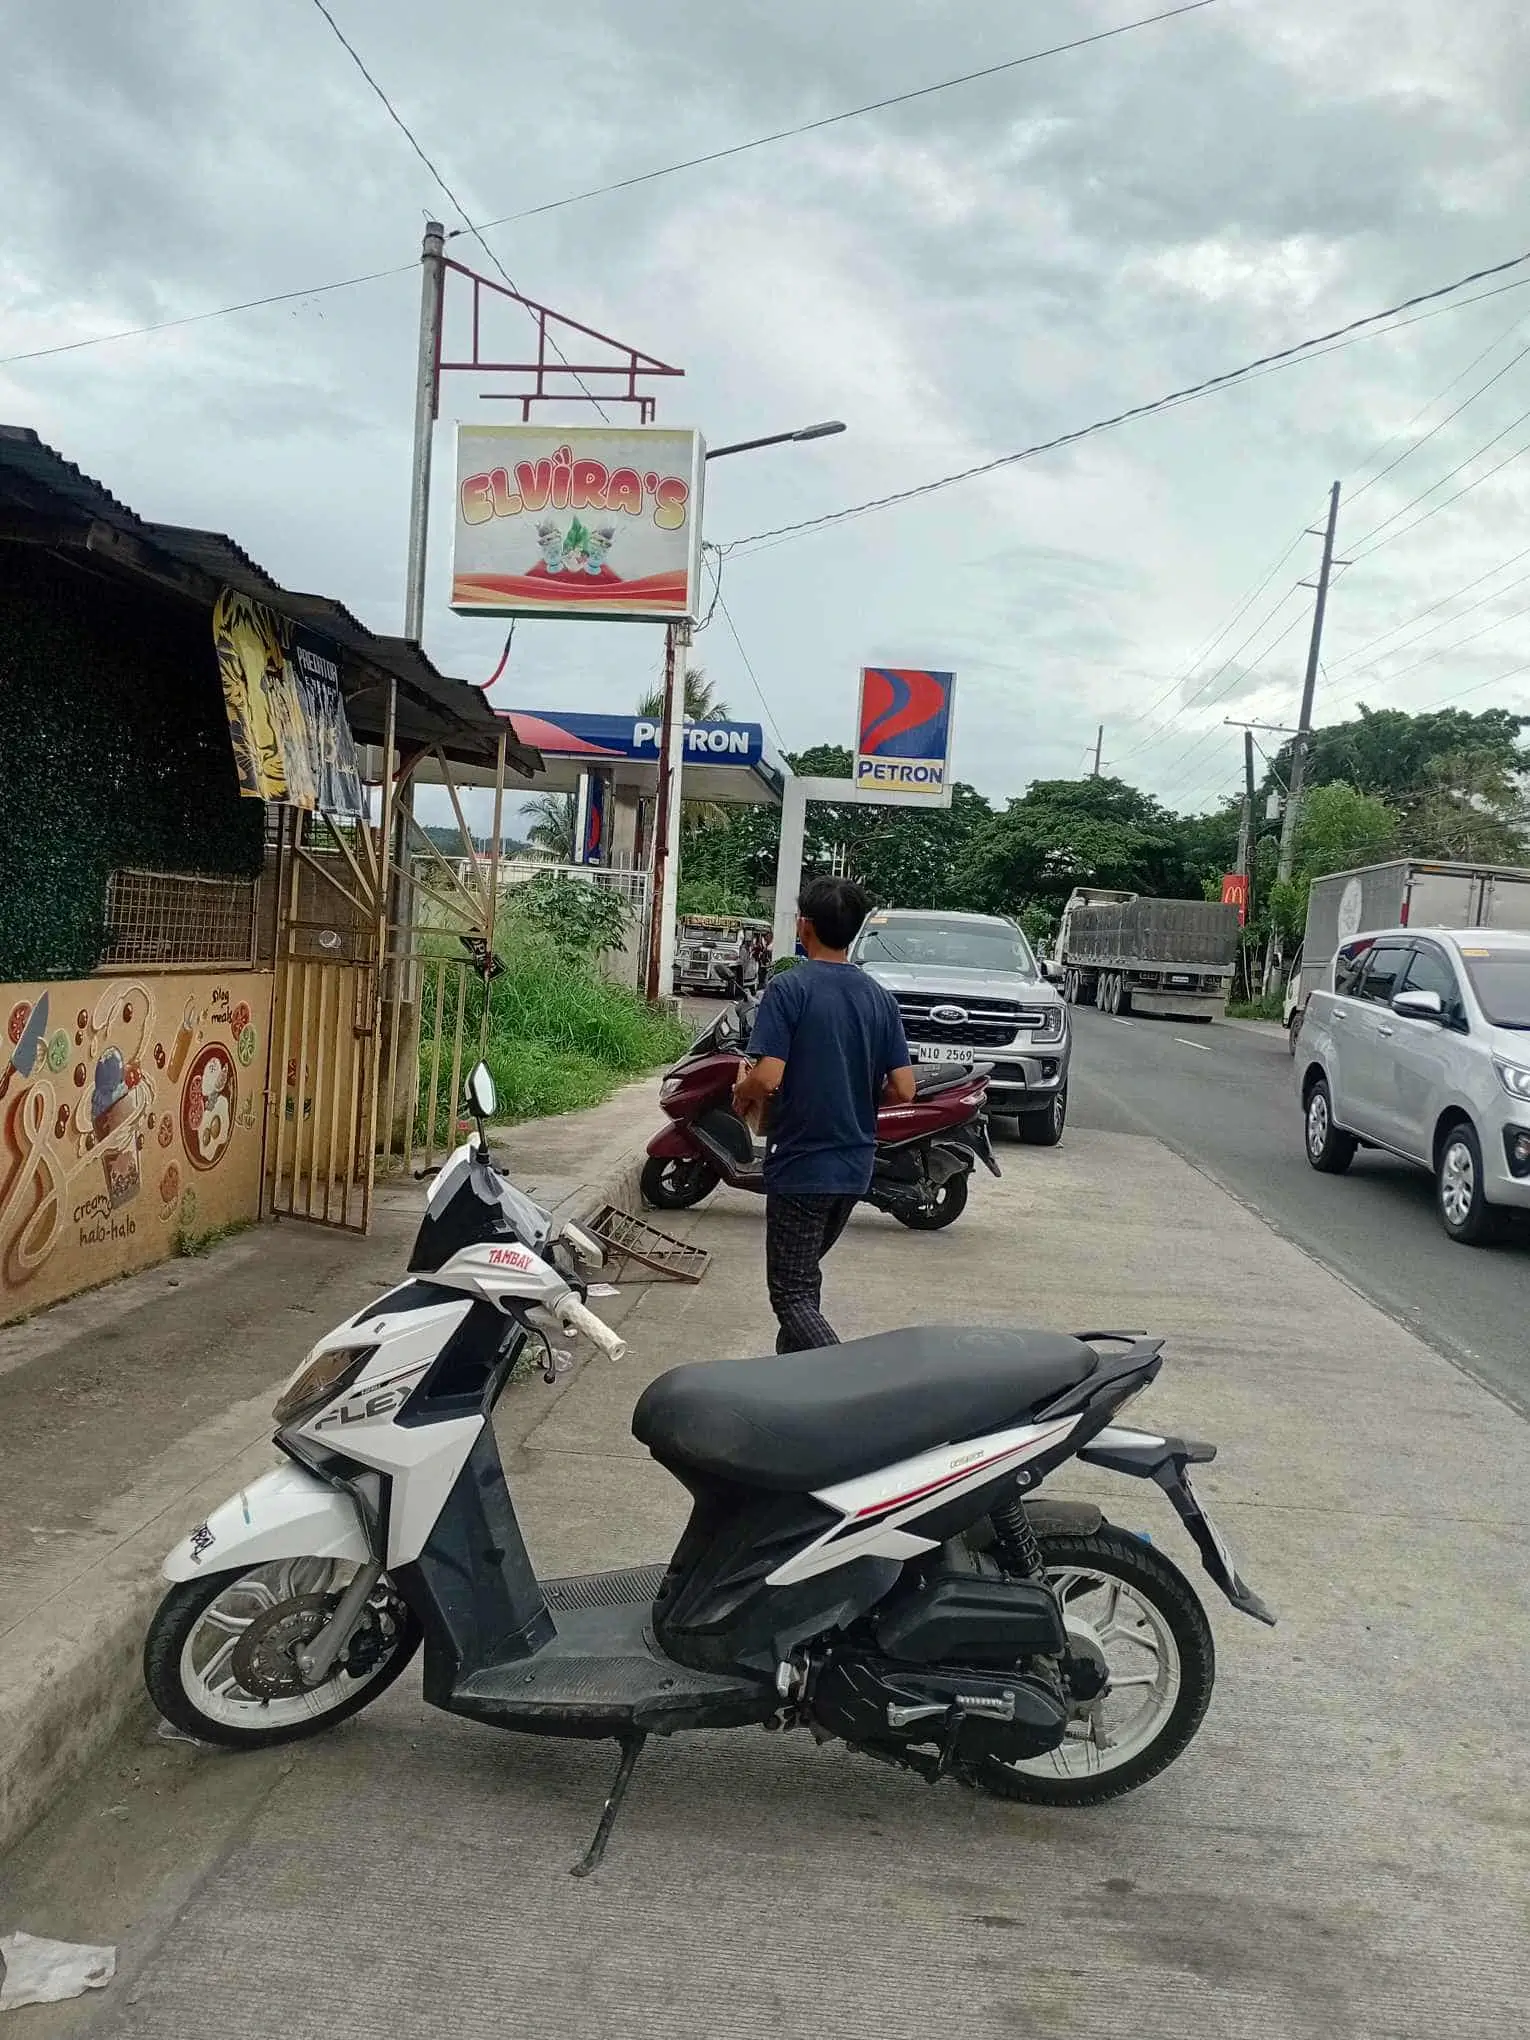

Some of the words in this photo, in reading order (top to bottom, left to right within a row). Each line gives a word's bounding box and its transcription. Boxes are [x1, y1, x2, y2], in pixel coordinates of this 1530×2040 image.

[858, 760, 943, 783] PETRON
[946, 1049, 972, 1061] 2569
[80, 1214, 136, 1247] halo-halo
[488, 1248, 533, 1270] TAMBAY
